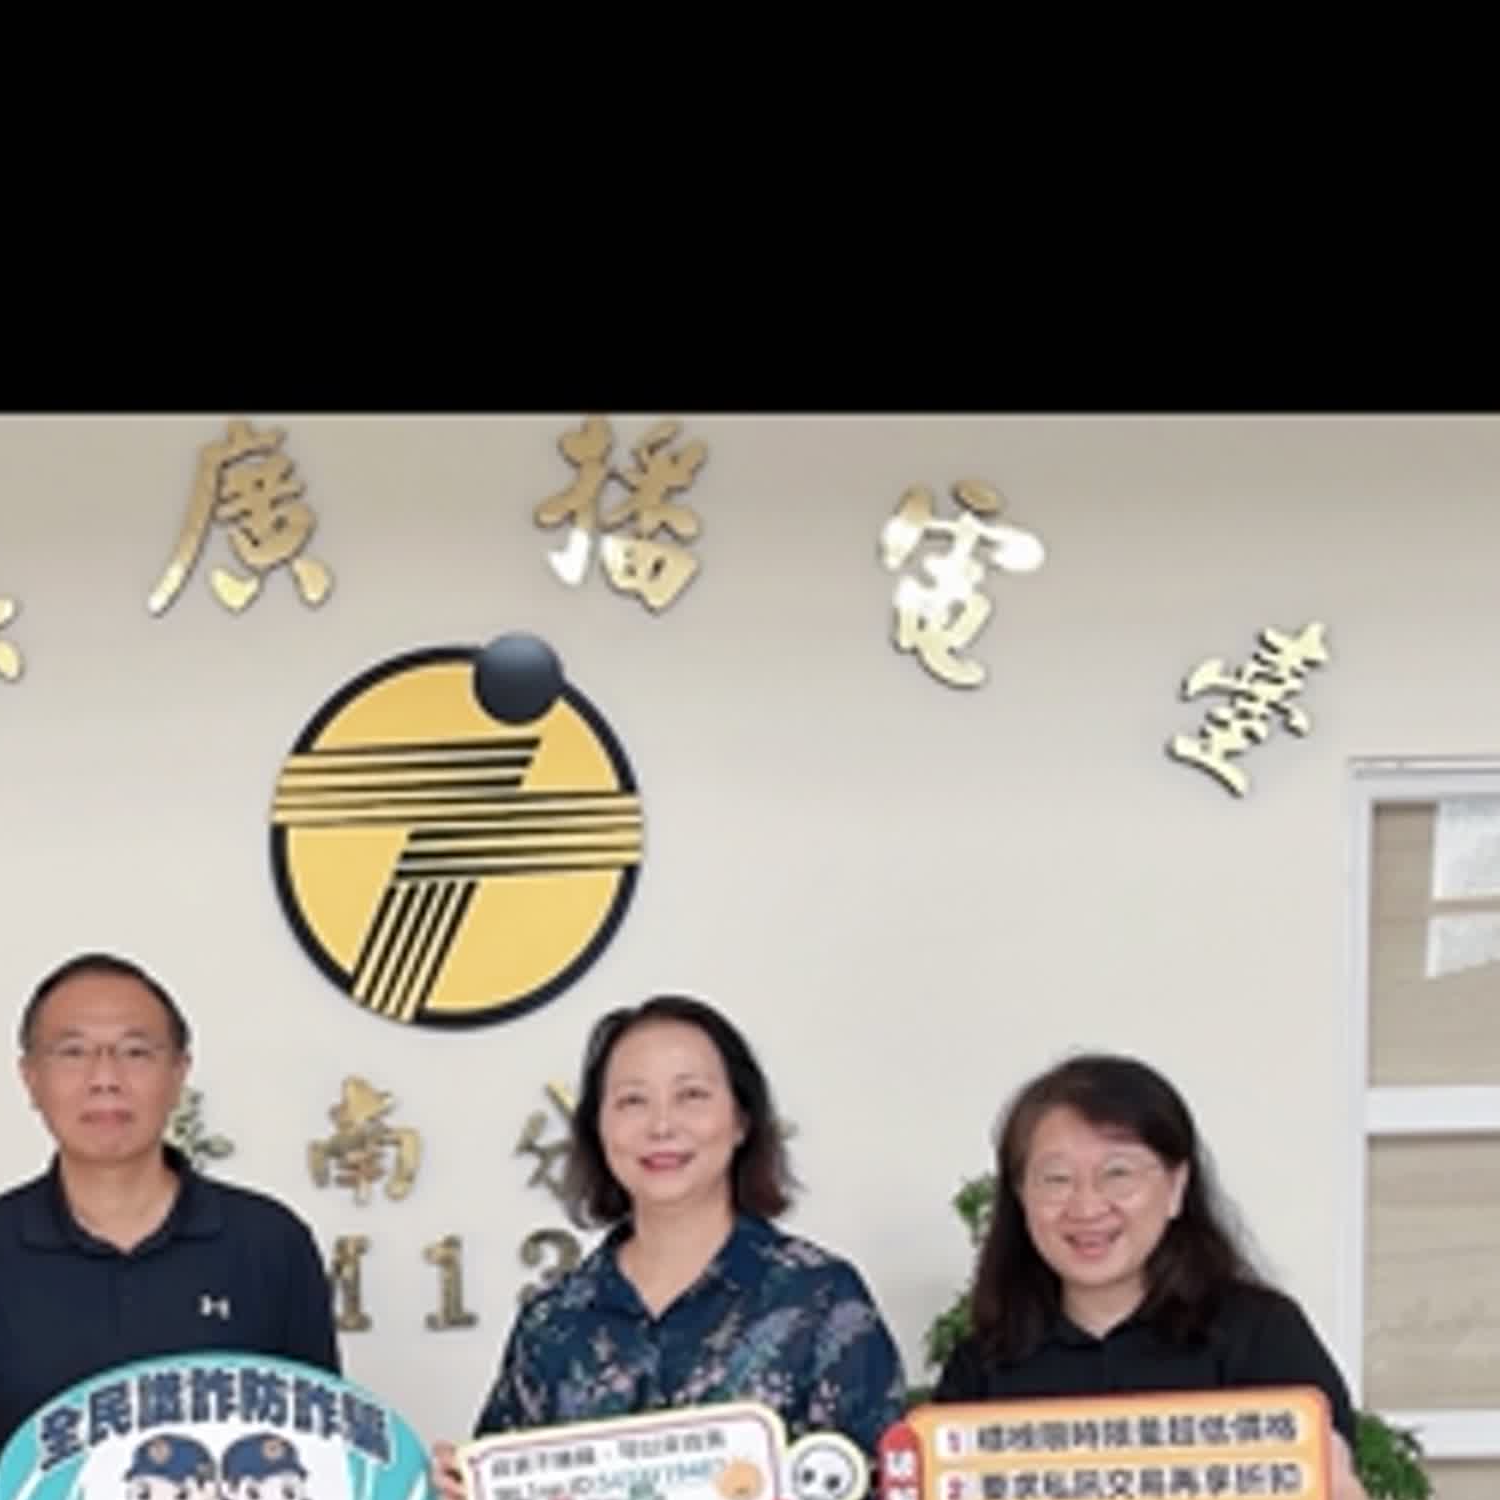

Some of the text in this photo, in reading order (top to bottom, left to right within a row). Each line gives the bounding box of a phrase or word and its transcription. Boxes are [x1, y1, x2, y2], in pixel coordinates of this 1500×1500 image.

[41, 1368, 391, 1471] 全民識詐防詐騙
